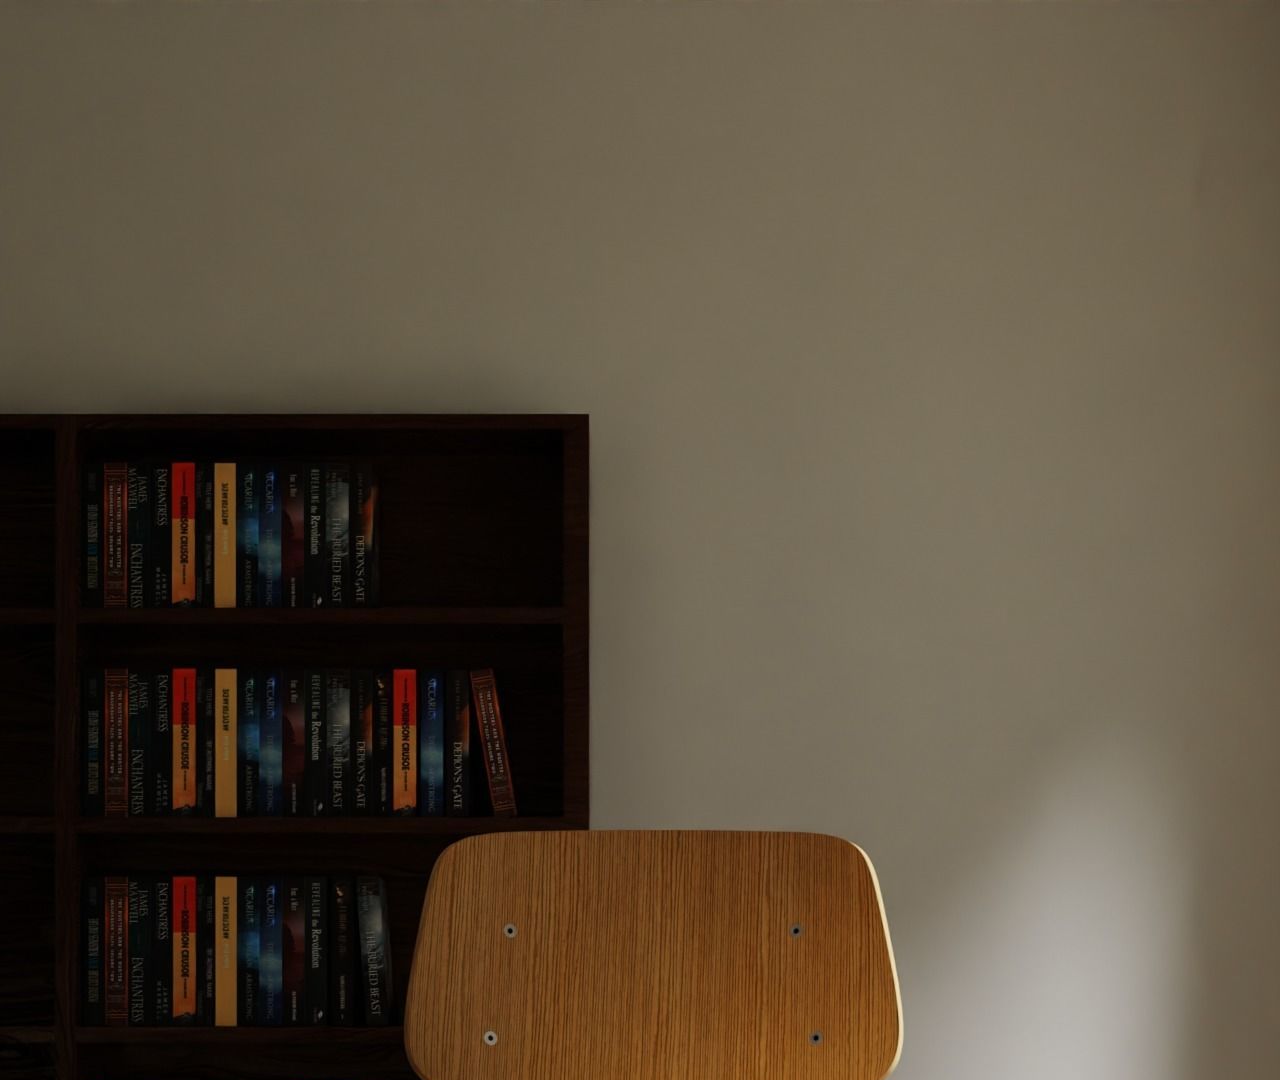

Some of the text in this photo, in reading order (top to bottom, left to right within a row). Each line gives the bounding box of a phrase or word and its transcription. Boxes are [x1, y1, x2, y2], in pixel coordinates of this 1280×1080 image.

[310, 515, 321, 555] Revolution
[311, 721, 322, 761] Revolution
[311, 929, 322, 968] Revolution
